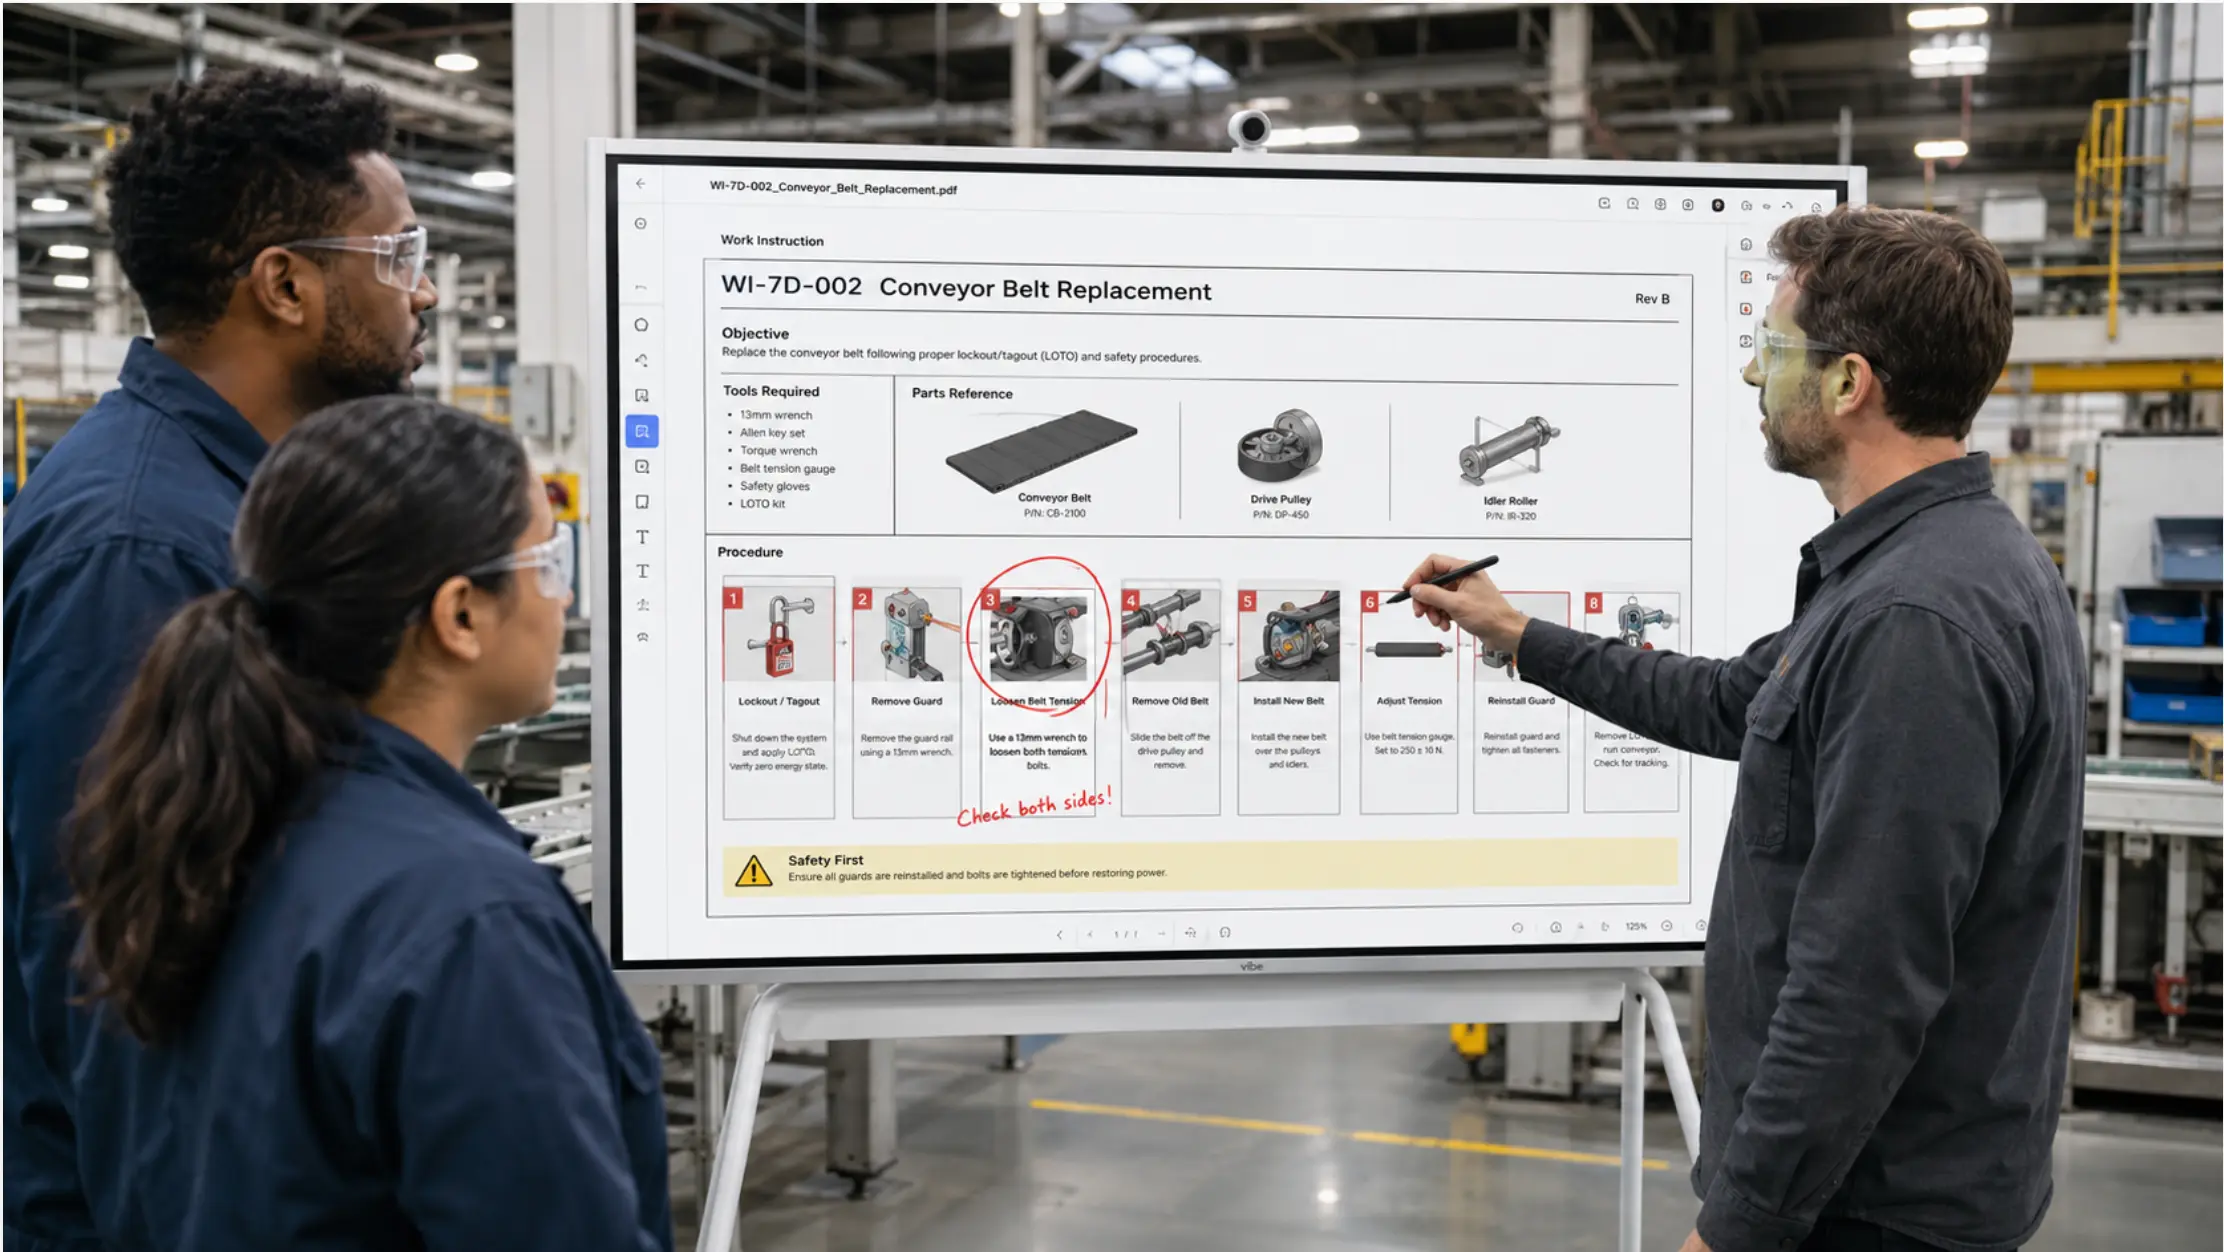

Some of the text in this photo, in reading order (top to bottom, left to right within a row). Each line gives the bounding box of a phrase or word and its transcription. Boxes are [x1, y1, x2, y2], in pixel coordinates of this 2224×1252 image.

[710, 181, 957, 197] WI-7D-002_Conveyor_Belt_Replacement.pdf
[721, 235, 824, 247] Work Instruction
[721, 275, 1212, 303] WI-7D-002 Conveyor Belt Replacement
[1636, 293, 1670, 304] Rev B
[722, 327, 789, 342] Objective
[722, 346, 1202, 364] Replace the conveyor belt following proper lockout/tagout (LOTO) and safety procedures.
[723, 385, 820, 399] Tools Required
[912, 387, 1013, 399] Parts Reference
[741, 409, 813, 421] 13mm wrench
[740, 427, 805, 440] Allen key set
[741, 445, 817, 457] Torque wrench
[740, 463, 836, 476] Belt tension gauge
[741, 481, 810, 493] Safety gloves
[741, 498, 785, 509] LOTO kit
[1018, 492, 1091, 504] Conveyor Belt
[1251, 494, 1312, 506] Drive Pulley
[1484, 495, 1538, 507] Idler Roller
[1046, 508, 1086, 519] CB-2100
[1275, 509, 1310, 520] DP-450
[718, 547, 783, 558] Procedure
[730, 593, 736, 605] 1
[858, 593, 867, 605] 2
[986, 593, 995, 606] 3
[1126, 595, 1135, 607] 4
[1243, 595, 1252, 608] 5
[1366, 596, 1375, 608] 6
[1590, 597, 1598, 609] 8
[739, 696, 820, 707] Lockout / Tagout
[871, 696, 943, 707] Remove Guard
[991, 696, 1085, 707] Loosen Belt Tension
[1132, 696, 1209, 706] Remove Old Belt
[1254, 696, 1324, 706] Install New Belt
[1377, 696, 1442, 707] Adjust Tension
[1488, 696, 1556, 707] Reinstall Guard
[732, 732, 752, 743] Shut
[754, 733, 779, 744] down
[780, 733, 795, 743] the
[861, 733, 954, 744] Remove the guard rail
[988, 733, 1006, 743] Use
[1008, 734, 1014, 743] a
[1044, 733, 1076, 743] wrench
[1078, 733, 1088, 743] to
[1130, 732, 1210, 742] Slide the belt off the
[1251, 732, 1327, 742] Install the new belt
[1364, 732, 1380, 742] Use
[1382, 732, 1397, 741] belt
[1398, 732, 1427, 741] tension
[1484, 731, 1560, 743] Reinstall guard and
[1595, 731, 1627, 740] Remove
[860, 748, 884, 759] using
[885, 749, 891, 757] a
[1138, 746, 1204, 757] drive pulley and
[1255, 748, 1272, 756] over
[1275, 747, 1288, 756] the
[1512, 745, 1521, 755] all
[1603, 746, 1618, 754] run
[755, 763, 773, 771] zero
[775, 763, 803, 773] energy
[805, 761, 828, 771] state.
[1027, 760, 1050, 771] bolts.
[1594, 758, 1669, 769] Check for tracking.
[957, 784, 1112, 827] Check both sides!
[789, 855, 864, 868] Safety First
[789, 868, 1167, 883] Ensure all guards are reinstalled and bolts are tightened before restoring power.
[1240, 961, 1264, 971] vibe
